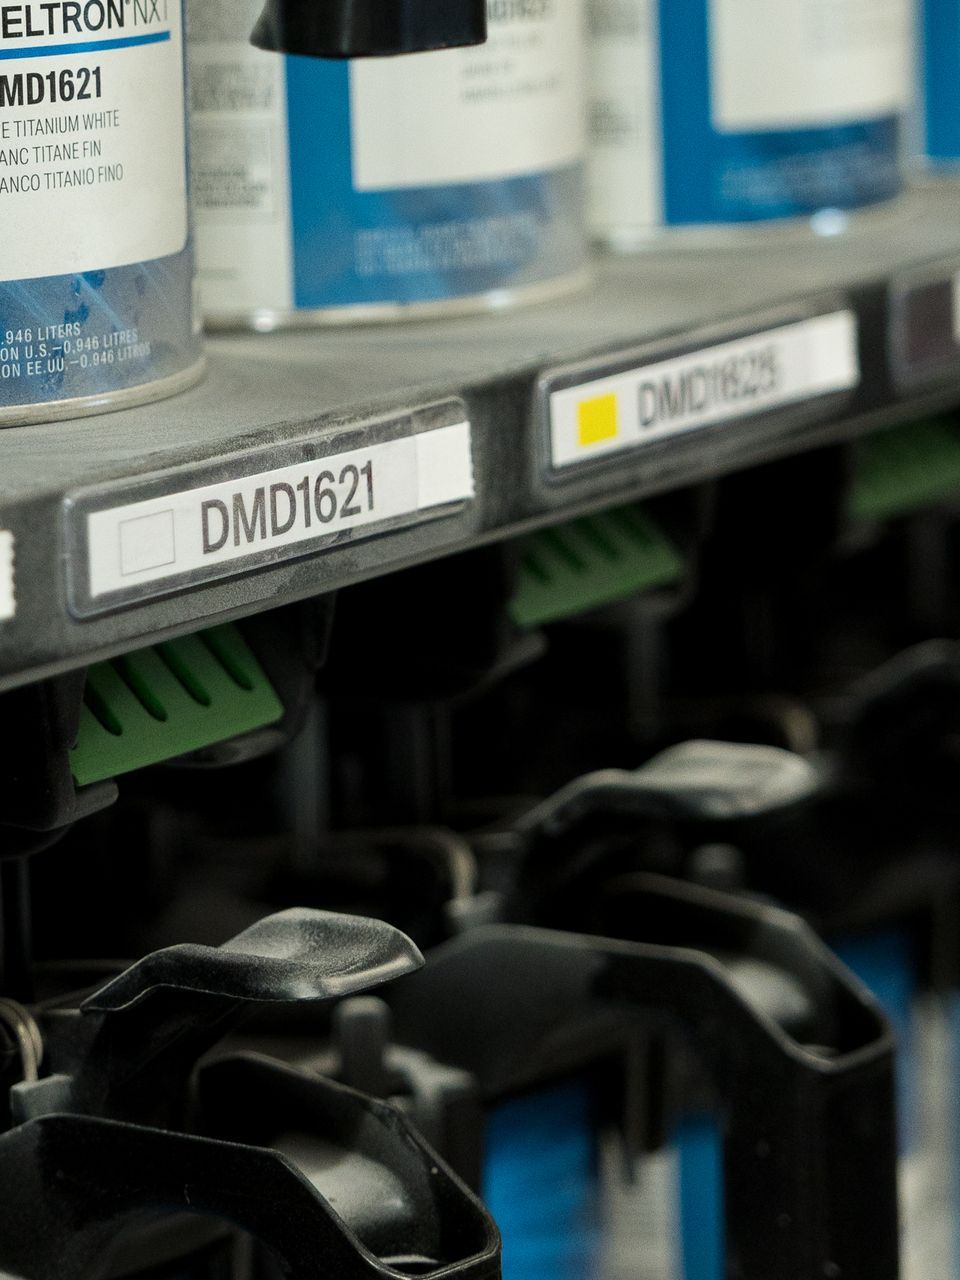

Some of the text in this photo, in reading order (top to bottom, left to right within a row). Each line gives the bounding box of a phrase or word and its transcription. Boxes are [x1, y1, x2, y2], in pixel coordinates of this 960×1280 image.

[13, 115, 79, 138] TITANIUM
[82, 109, 120, 131] WHITE
[32, 142, 80, 163] TITANE
[82, 140, 102, 159] FIN
[44, 167, 95, 190] TITANIO
[97, 163, 124, 183] FINO
[38, 322, 81, 341] LITERS
[103, 328, 138, 348] LITRES
[200, 458, 375, 556] DMD1621
